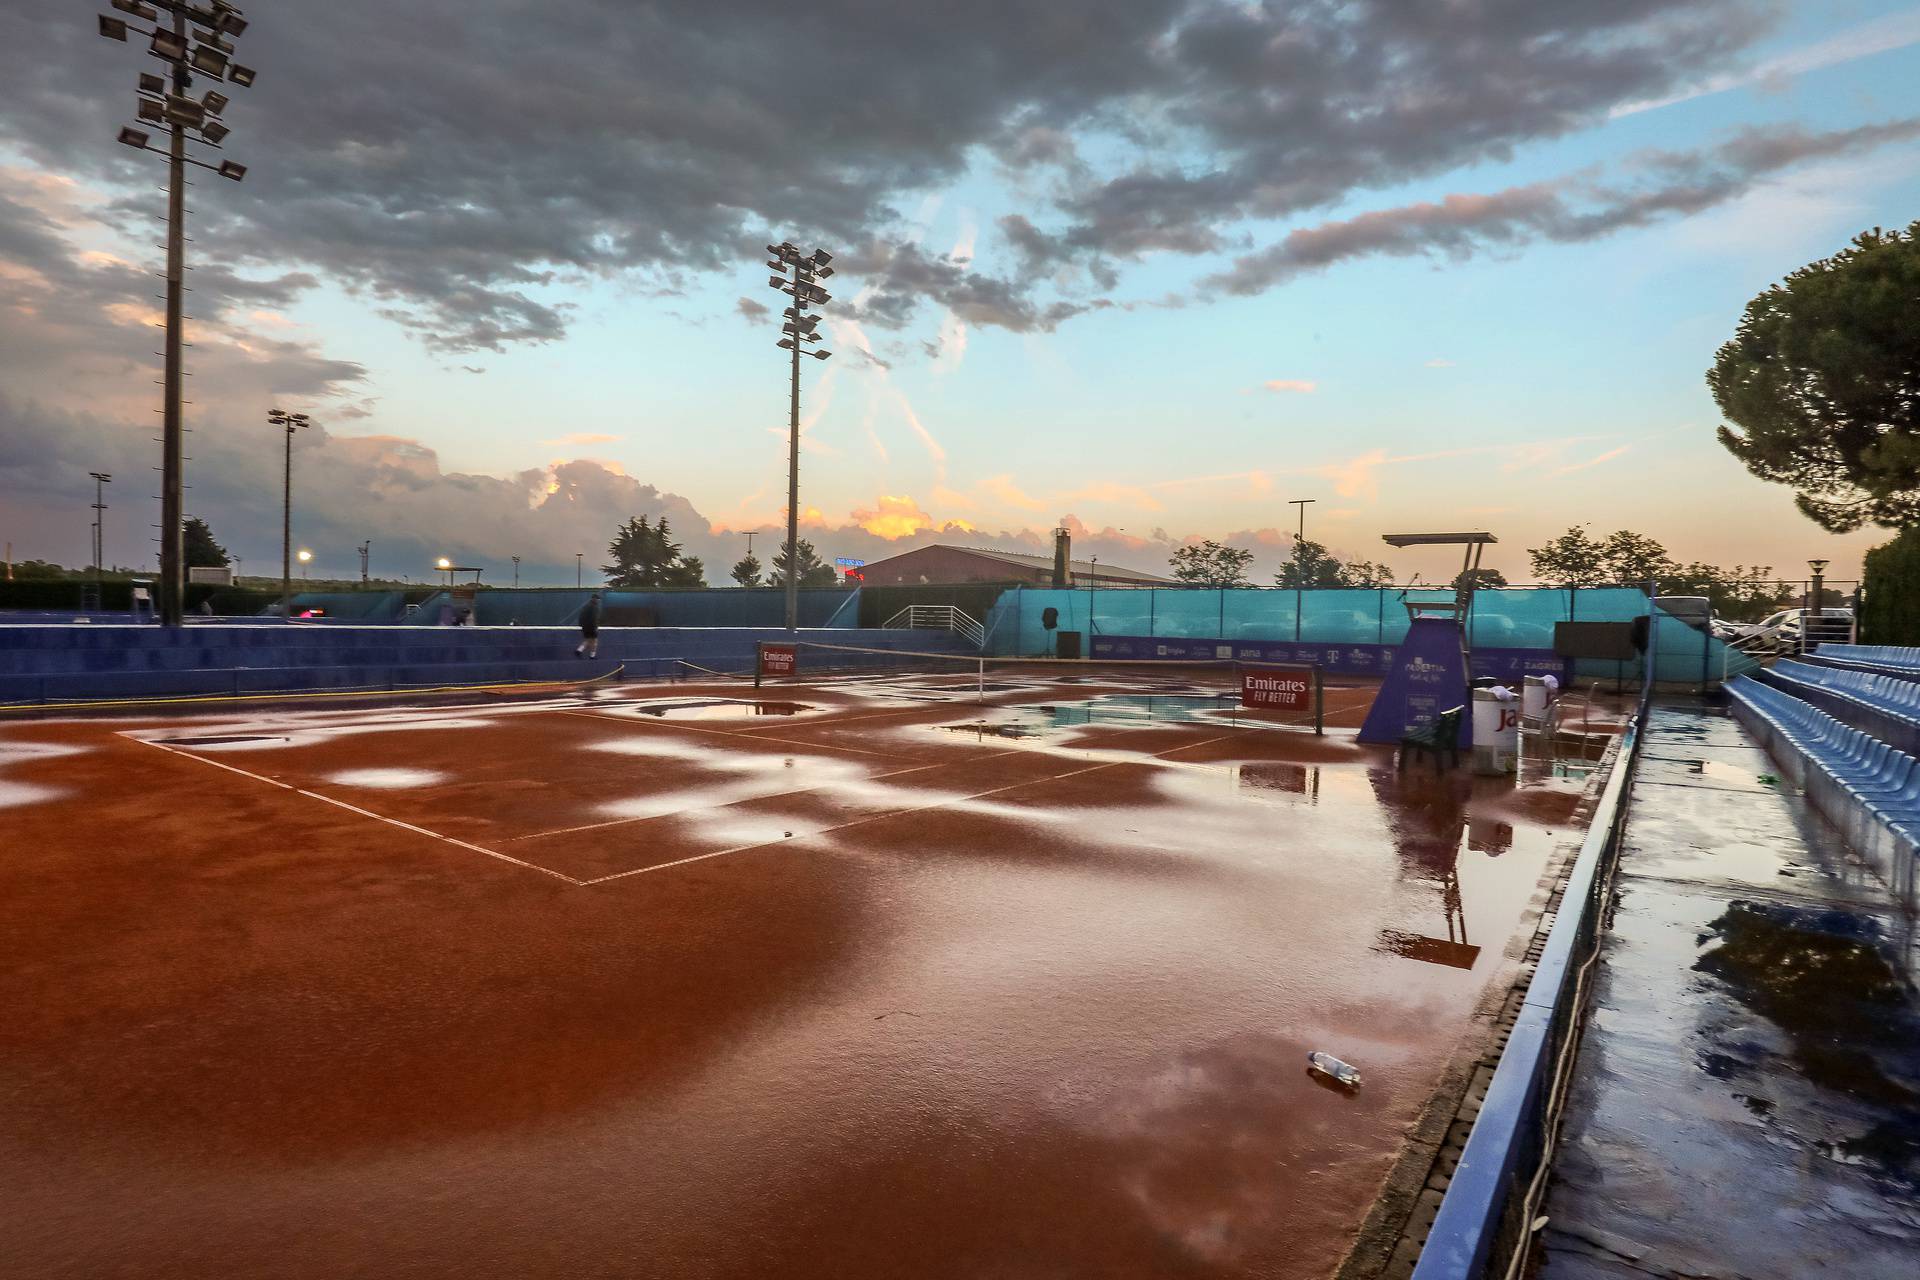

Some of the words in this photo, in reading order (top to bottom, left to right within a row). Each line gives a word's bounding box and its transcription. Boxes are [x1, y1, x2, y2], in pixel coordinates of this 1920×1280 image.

[763, 651, 794, 662] Emirates
[1245, 675, 1306, 692] Emirates
[1254, 692, 1267, 702] FLY
[1268, 692, 1297, 704] BETTER
